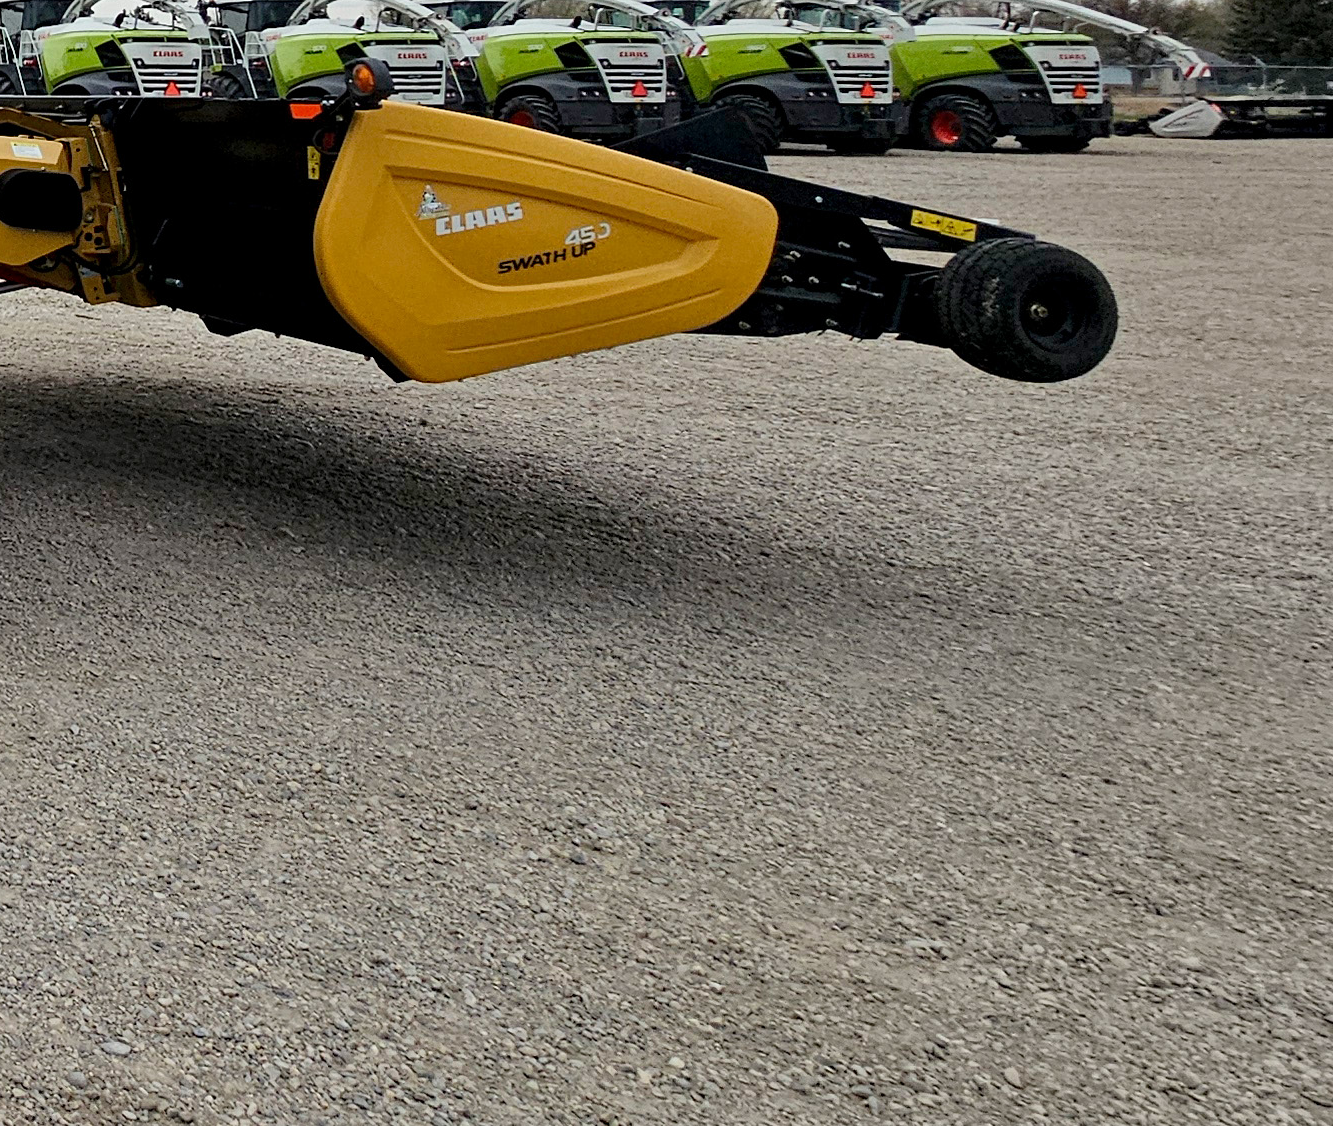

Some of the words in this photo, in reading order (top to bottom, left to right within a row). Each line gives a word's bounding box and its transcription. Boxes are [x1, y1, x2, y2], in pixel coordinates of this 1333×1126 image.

[153, 50, 184, 58] CLAAS
[435, 201, 523, 236] CLAAS
[497, 248, 567, 274] SWATH
[571, 241, 596, 258] UP
